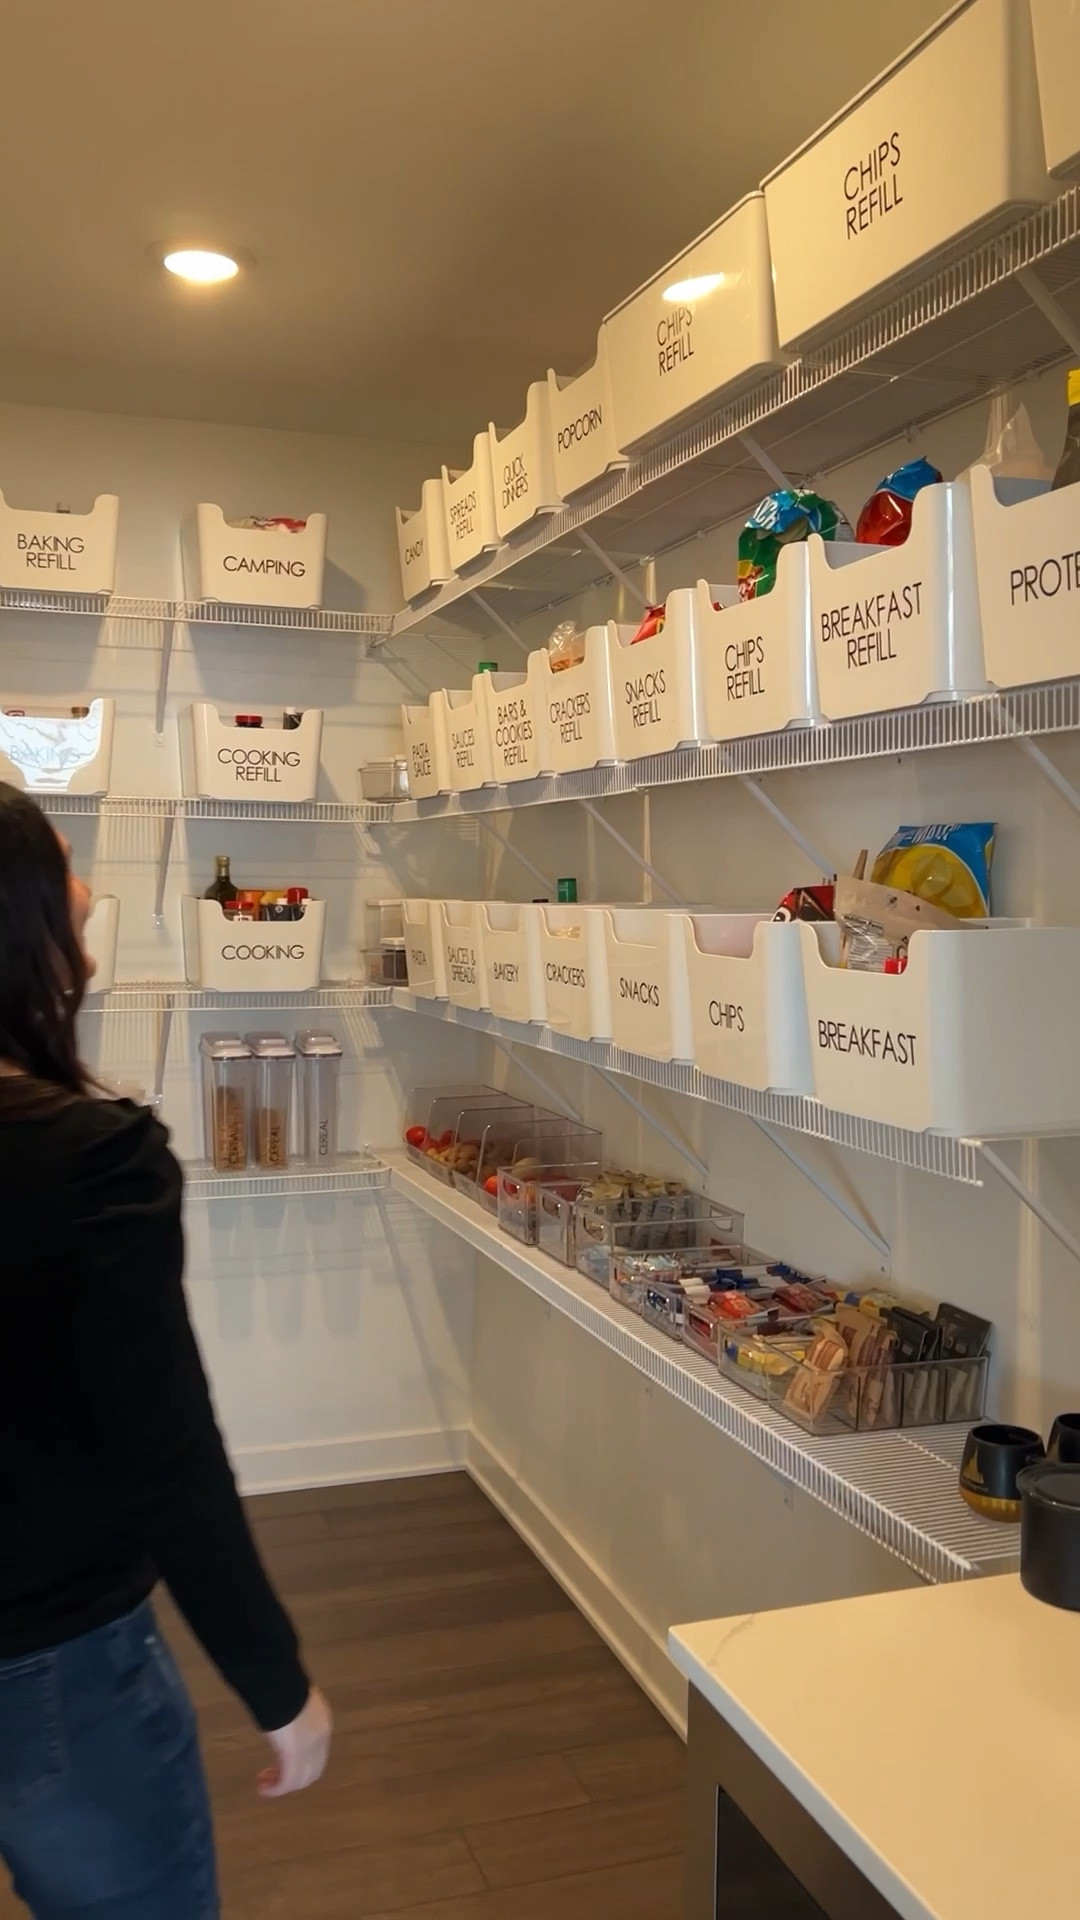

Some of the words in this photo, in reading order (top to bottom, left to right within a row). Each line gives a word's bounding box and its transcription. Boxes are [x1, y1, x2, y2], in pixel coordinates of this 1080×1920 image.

[844, 132, 901, 201] CHIPS
[847, 174, 903, 240] REFILL
[657, 304, 692, 346] CHIPS
[659, 334, 693, 377] REFILL
[557, 404, 602, 452] POPCORN
[503, 454, 524, 485] QUICK
[503, 473, 528, 509] DINNERS
[450, 491, 476, 525] SPREADS
[456, 516, 473, 541] REFILL
[17, 534, 84, 552] BAKING
[405, 538, 423, 565] CANDY
[26, 553, 76, 570] REFILL
[223, 556, 305, 576] CAMPING
[821, 583, 922, 641] BREAKFAST
[725, 636, 764, 672] CHIPS
[847, 629, 897, 668] REFILL
[625, 670, 665, 704] SNACKS
[727, 668, 765, 700] REFILL
[498, 703, 518, 725] BARS
[519, 698, 527, 718] &
[550, 693, 590, 723] CRACKERS
[632, 700, 661, 728] REFILL
[452, 729, 474, 749] SAUCES
[496, 720, 532, 746] COOKIES
[560, 723, 582, 743] REFILL
[218, 749, 300, 767] COOKING
[412, 743, 428, 758] PASTA
[457, 750, 473, 768] REFILL
[504, 746, 527, 766] REFILL
[236, 767, 281, 782] REFILL
[415, 761, 431, 777] SAUCE
[222, 945, 304, 959] COOKING
[494, 962, 518, 982] BAKERY
[547, 963, 585, 987] CRACKERS
[620, 978, 659, 1006] SNACKS
[709, 1001, 745, 1032] CHIPS
[818, 1020, 916, 1065] BREAKFAST
[269, 1125, 280, 1163] CEREAL
[318, 1118, 329, 1157] CEREAL
